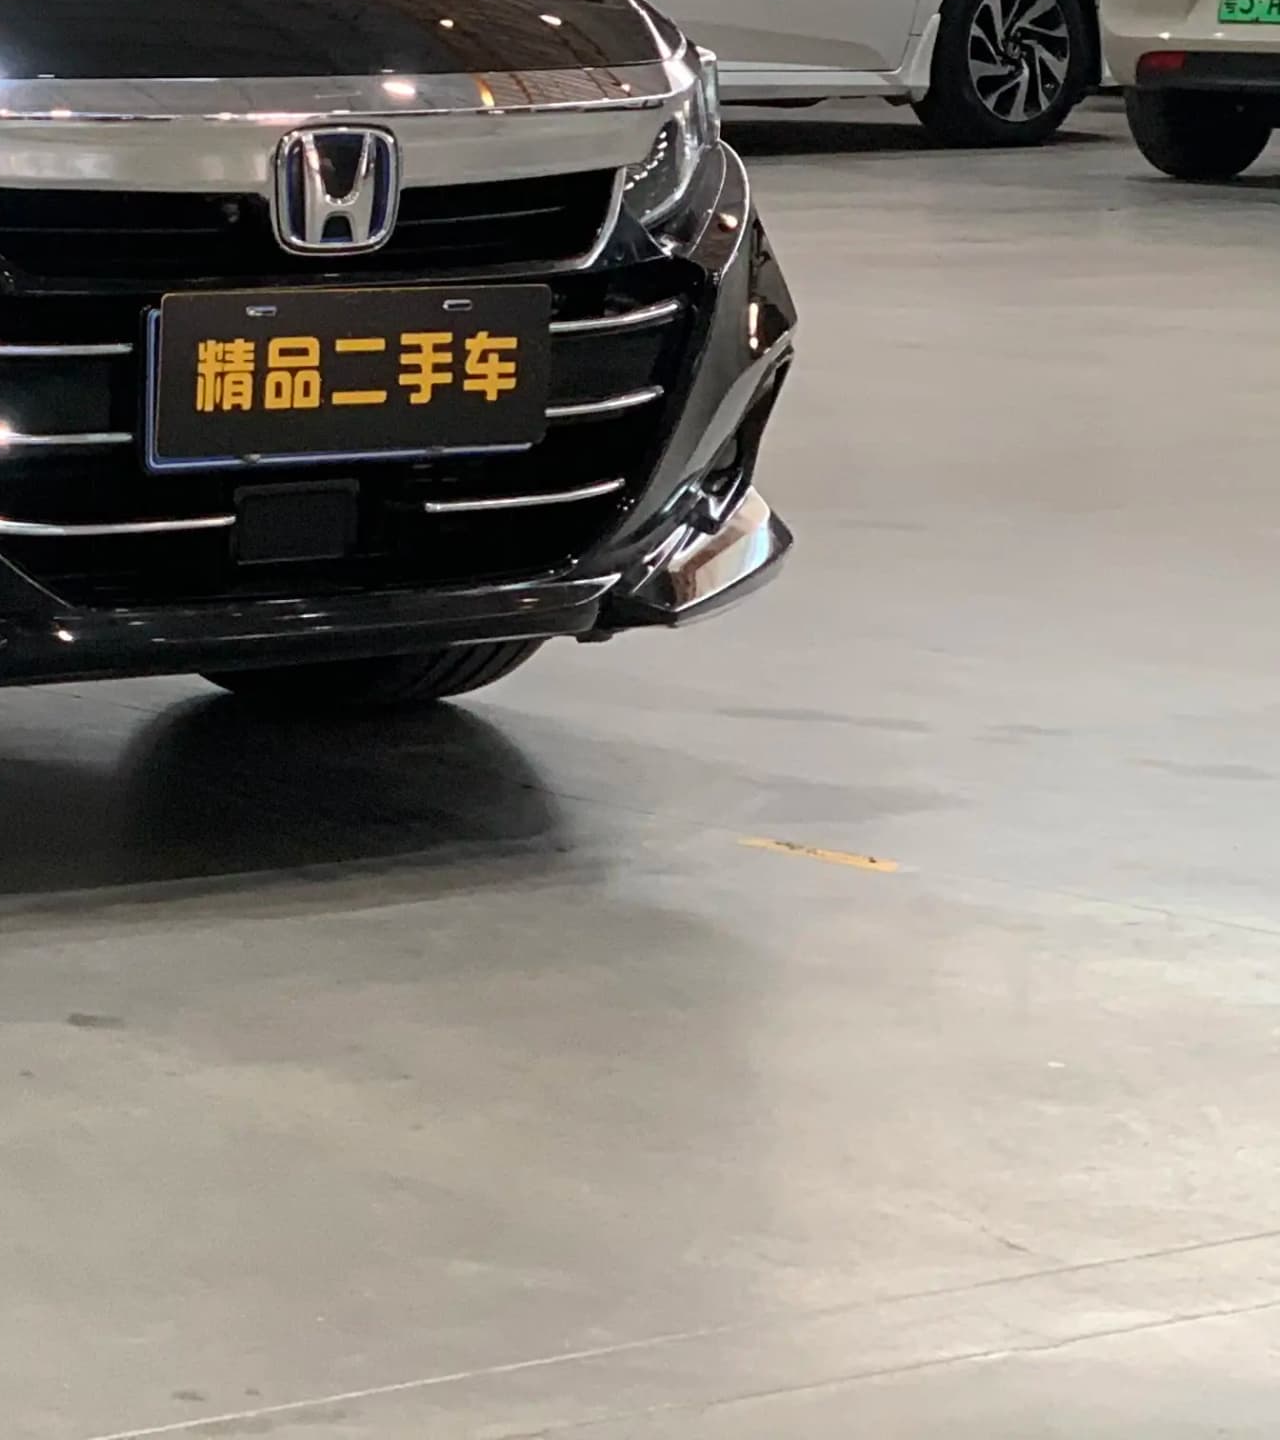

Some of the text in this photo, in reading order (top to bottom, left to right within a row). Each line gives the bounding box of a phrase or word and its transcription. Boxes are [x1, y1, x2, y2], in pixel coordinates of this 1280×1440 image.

[195, 331, 518, 413] 精品二手车
